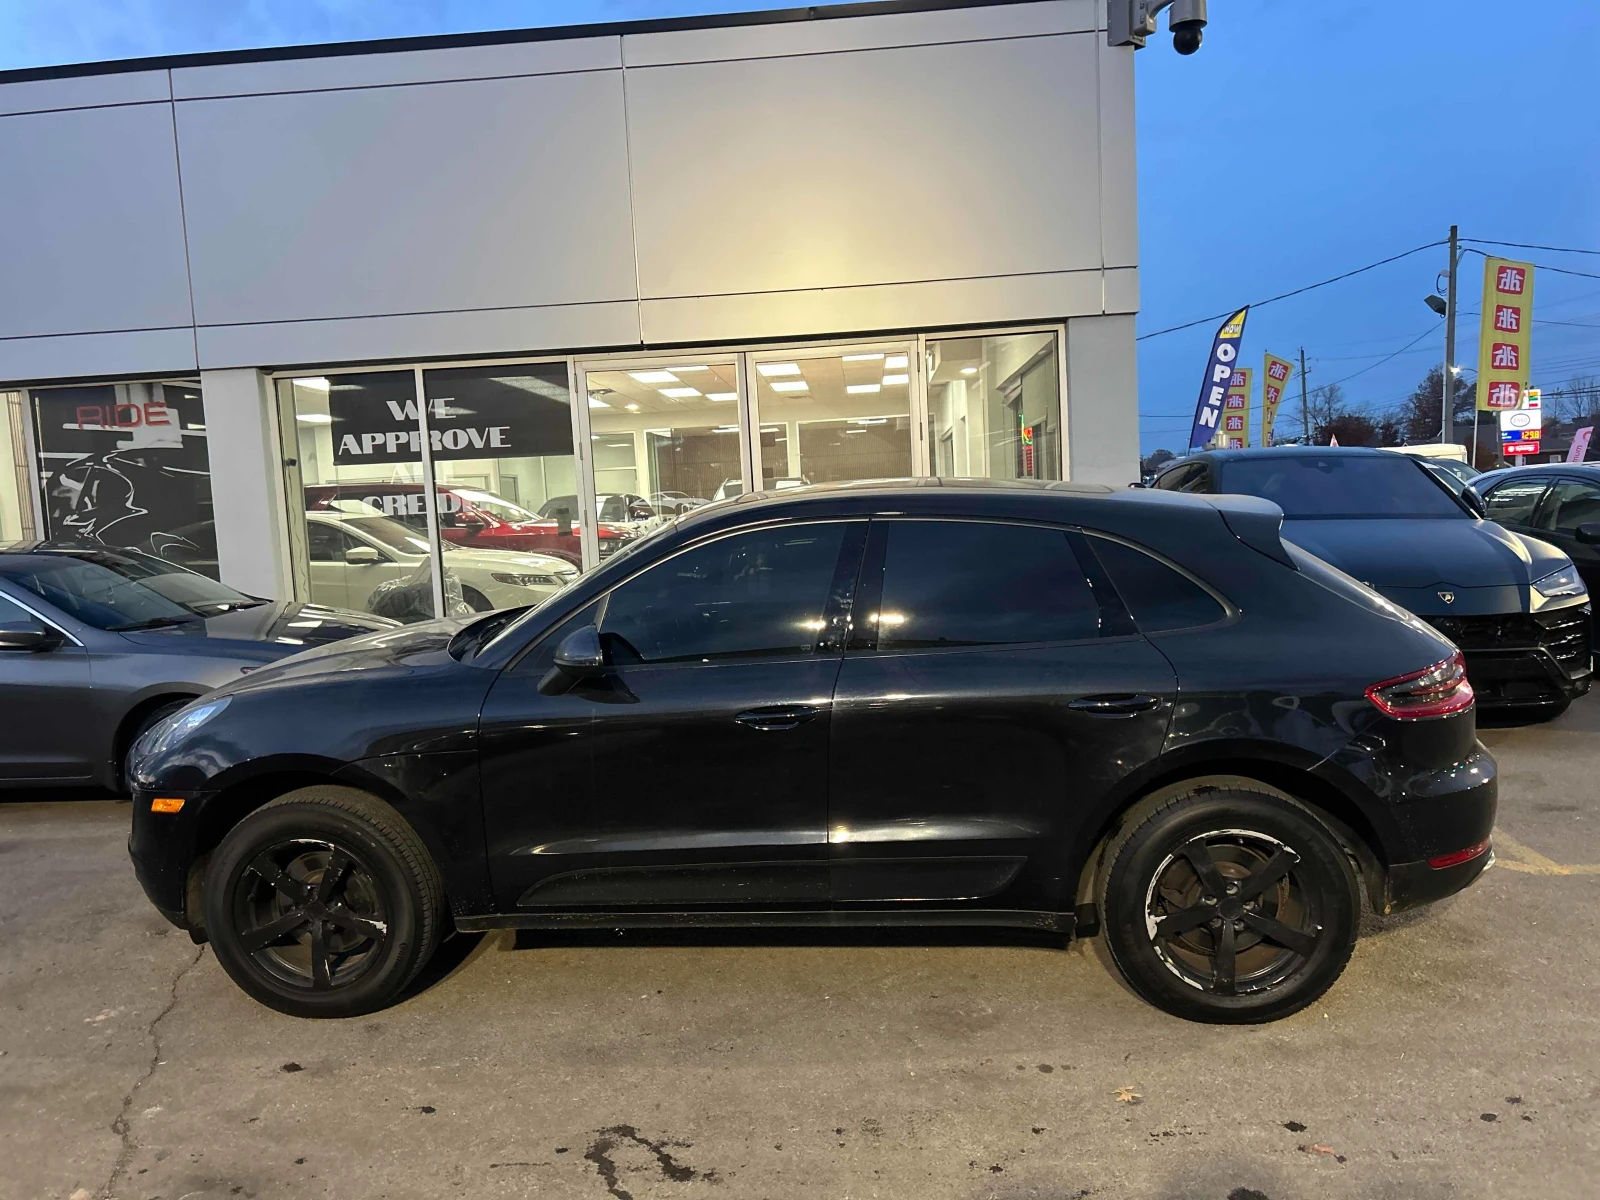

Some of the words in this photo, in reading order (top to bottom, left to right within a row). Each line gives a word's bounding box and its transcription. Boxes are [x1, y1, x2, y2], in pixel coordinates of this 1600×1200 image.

[1224, 324, 1241, 334] NOW
[1199, 343, 1236, 428] OPEN
[77, 401, 172, 429] RIDE
[386, 398, 457, 421] WE
[338, 426, 511, 456] APPROVE
